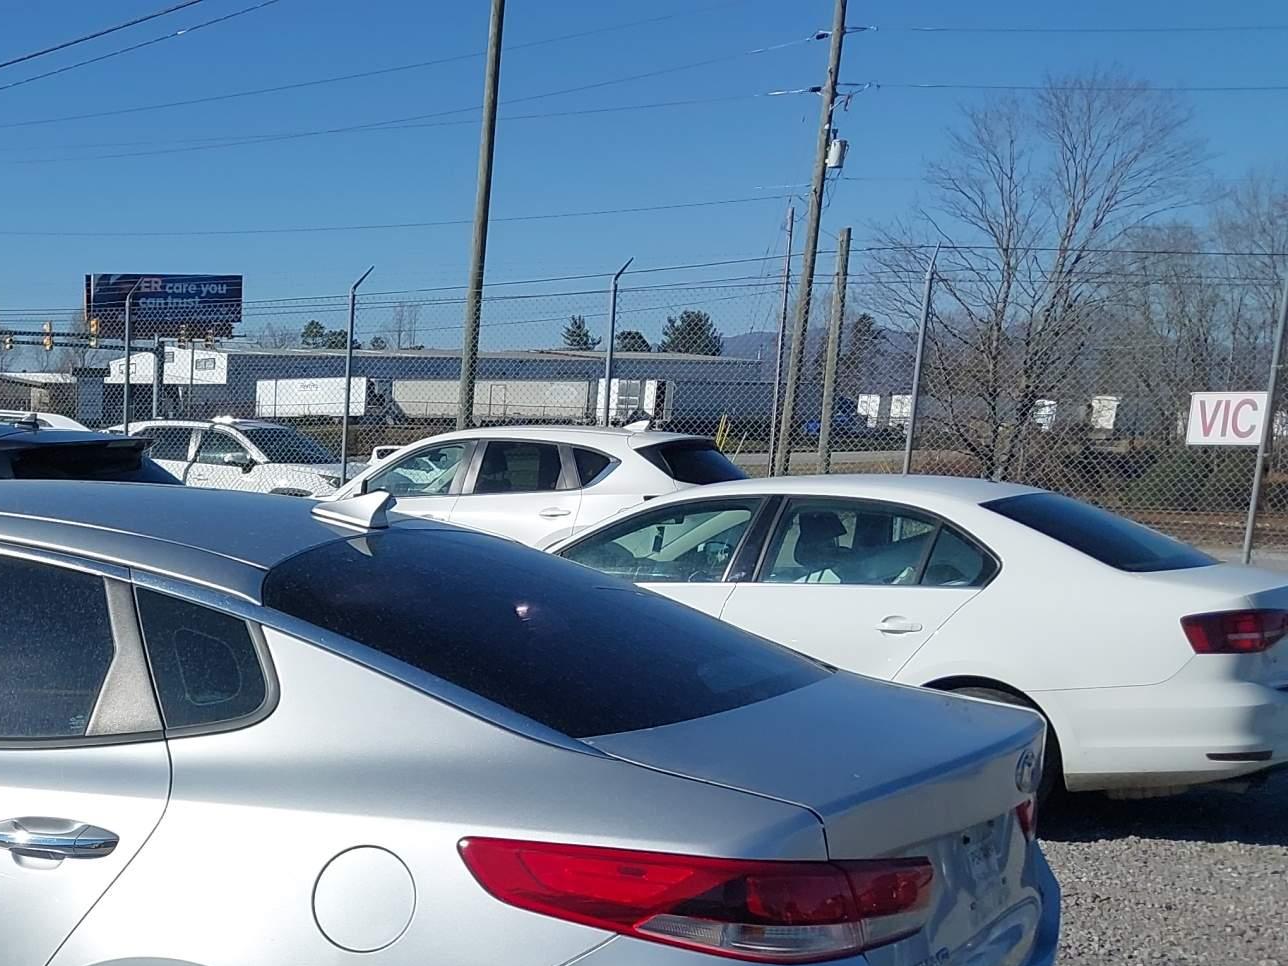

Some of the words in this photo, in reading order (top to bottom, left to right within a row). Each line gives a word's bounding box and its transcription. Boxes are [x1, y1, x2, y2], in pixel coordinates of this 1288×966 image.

[141, 278, 162, 291] ER
[166, 282, 197, 294] care
[200, 283, 228, 297] you
[139, 298, 164, 309] can
[1199, 398, 1259, 438] VIC
